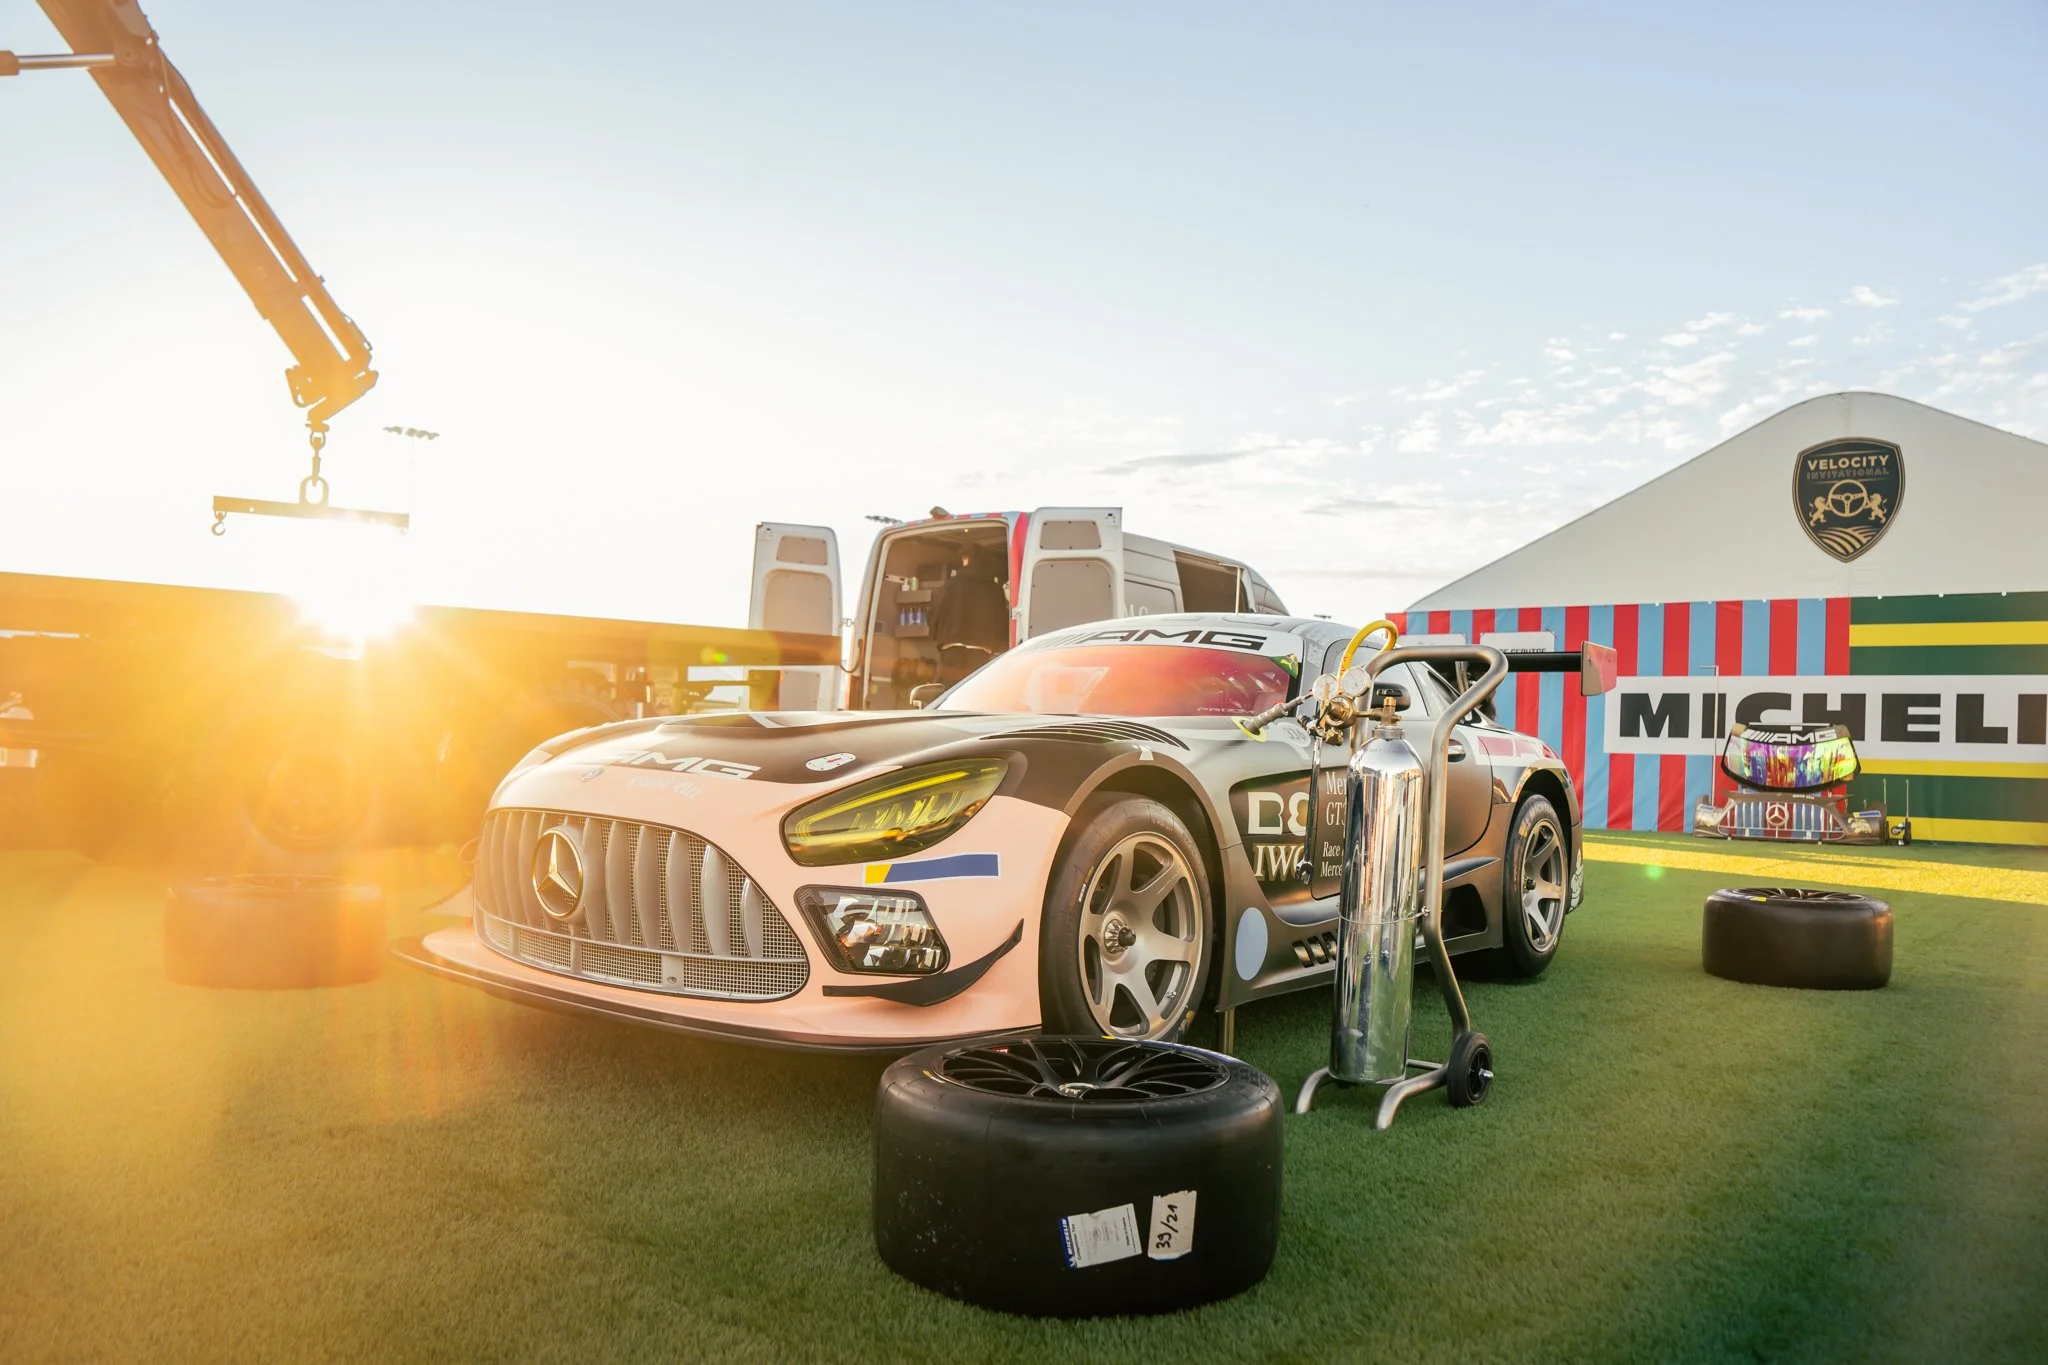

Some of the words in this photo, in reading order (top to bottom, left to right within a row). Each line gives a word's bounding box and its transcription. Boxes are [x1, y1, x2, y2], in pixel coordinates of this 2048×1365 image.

[1807, 454, 1889, 471] VELOCITY
[1806, 467, 1890, 480] INVITATIONAL
[1074, 629, 1267, 651] AMG
[1769, 729, 1838, 745] AMG
[1322, 841, 1341, 857] Race
[1062, 1218, 1073, 1255] MICHELIN
